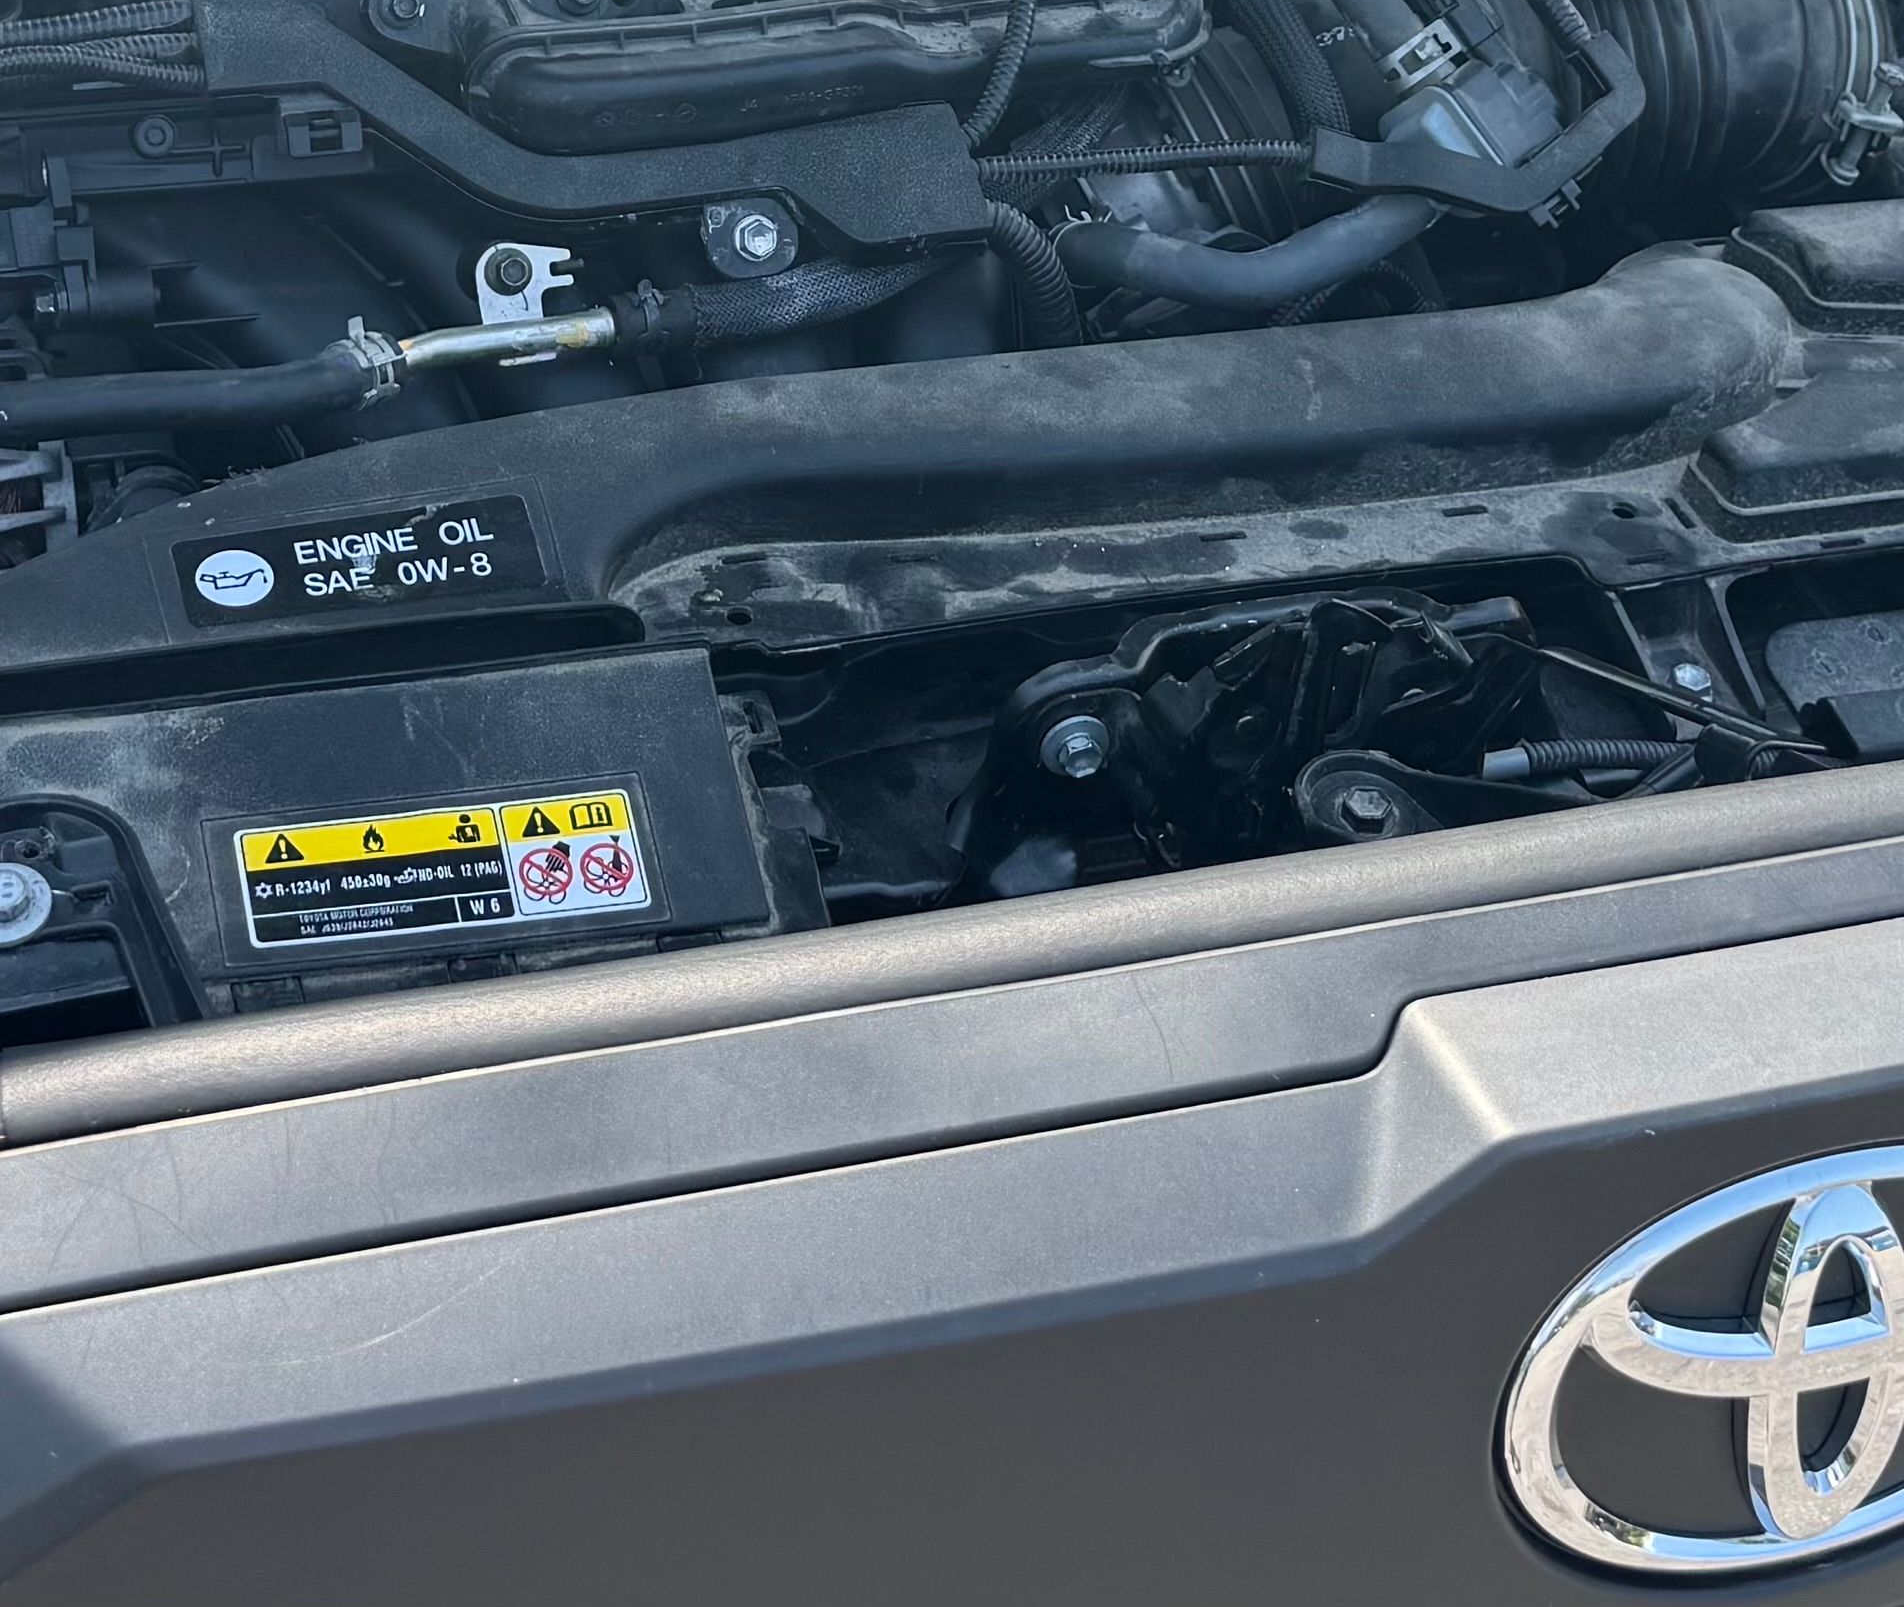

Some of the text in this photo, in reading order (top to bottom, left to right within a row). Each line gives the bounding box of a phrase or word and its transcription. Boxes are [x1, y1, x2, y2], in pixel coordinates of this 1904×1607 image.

[293, 517, 495, 565] ENGINE OIL
[303, 552, 493, 597] SAE 0W-8
[460, 863, 472, 877] 12
[475, 860, 503, 879] (PAG)
[469, 898, 501, 915] W 6
[299, 913, 329, 924] TOYOTA
